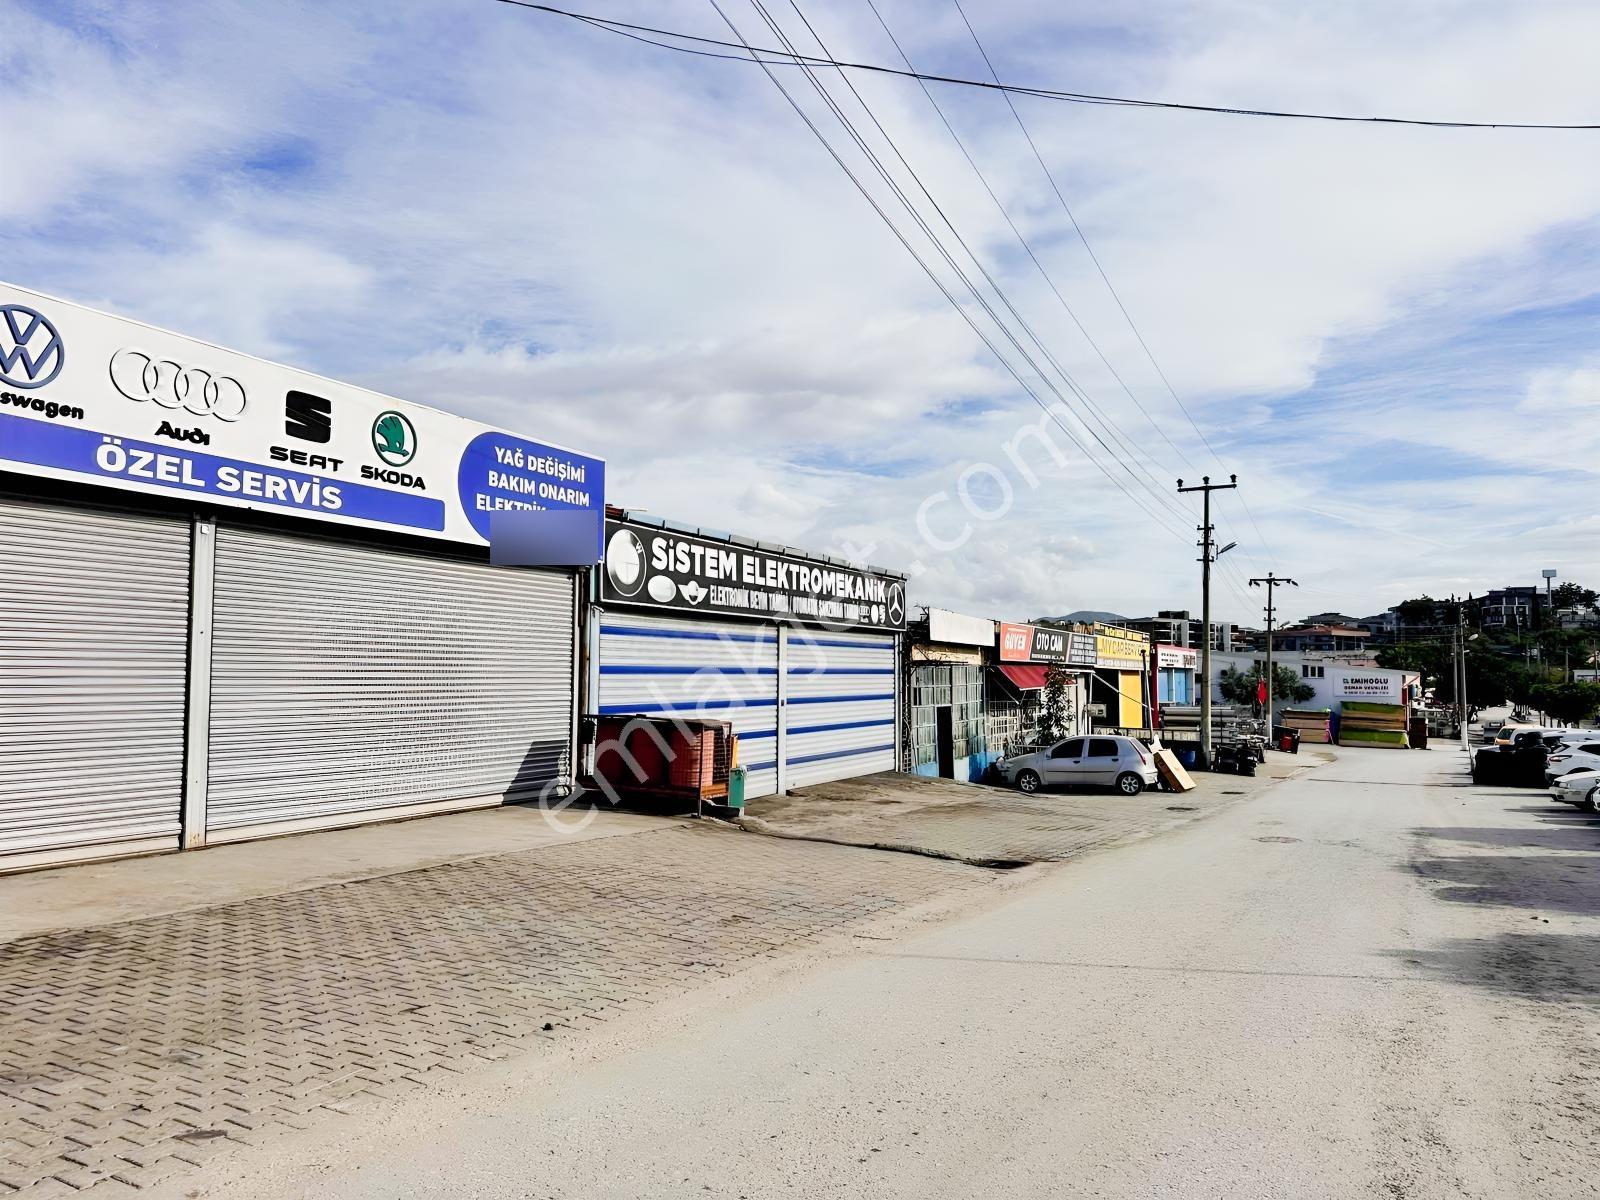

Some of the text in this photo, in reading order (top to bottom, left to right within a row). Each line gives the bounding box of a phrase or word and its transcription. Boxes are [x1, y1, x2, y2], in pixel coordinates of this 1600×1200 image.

[0, 392, 84, 419] swagen
[154, 421, 210, 445] Audi
[269, 446, 344, 472] SEAT
[495, 446, 585, 483] YAĞ DEĞİŞİMİ
[96, 436, 343, 510] ÖZEL SERVİS
[360, 465, 426, 490] SKODA
[488, 470, 590, 507] BAKIM ONARIM
[476, 493, 547, 511] ELEKTİ
[1036, 632, 1050, 651] OTO
[1050, 634, 1063, 652] CAM
